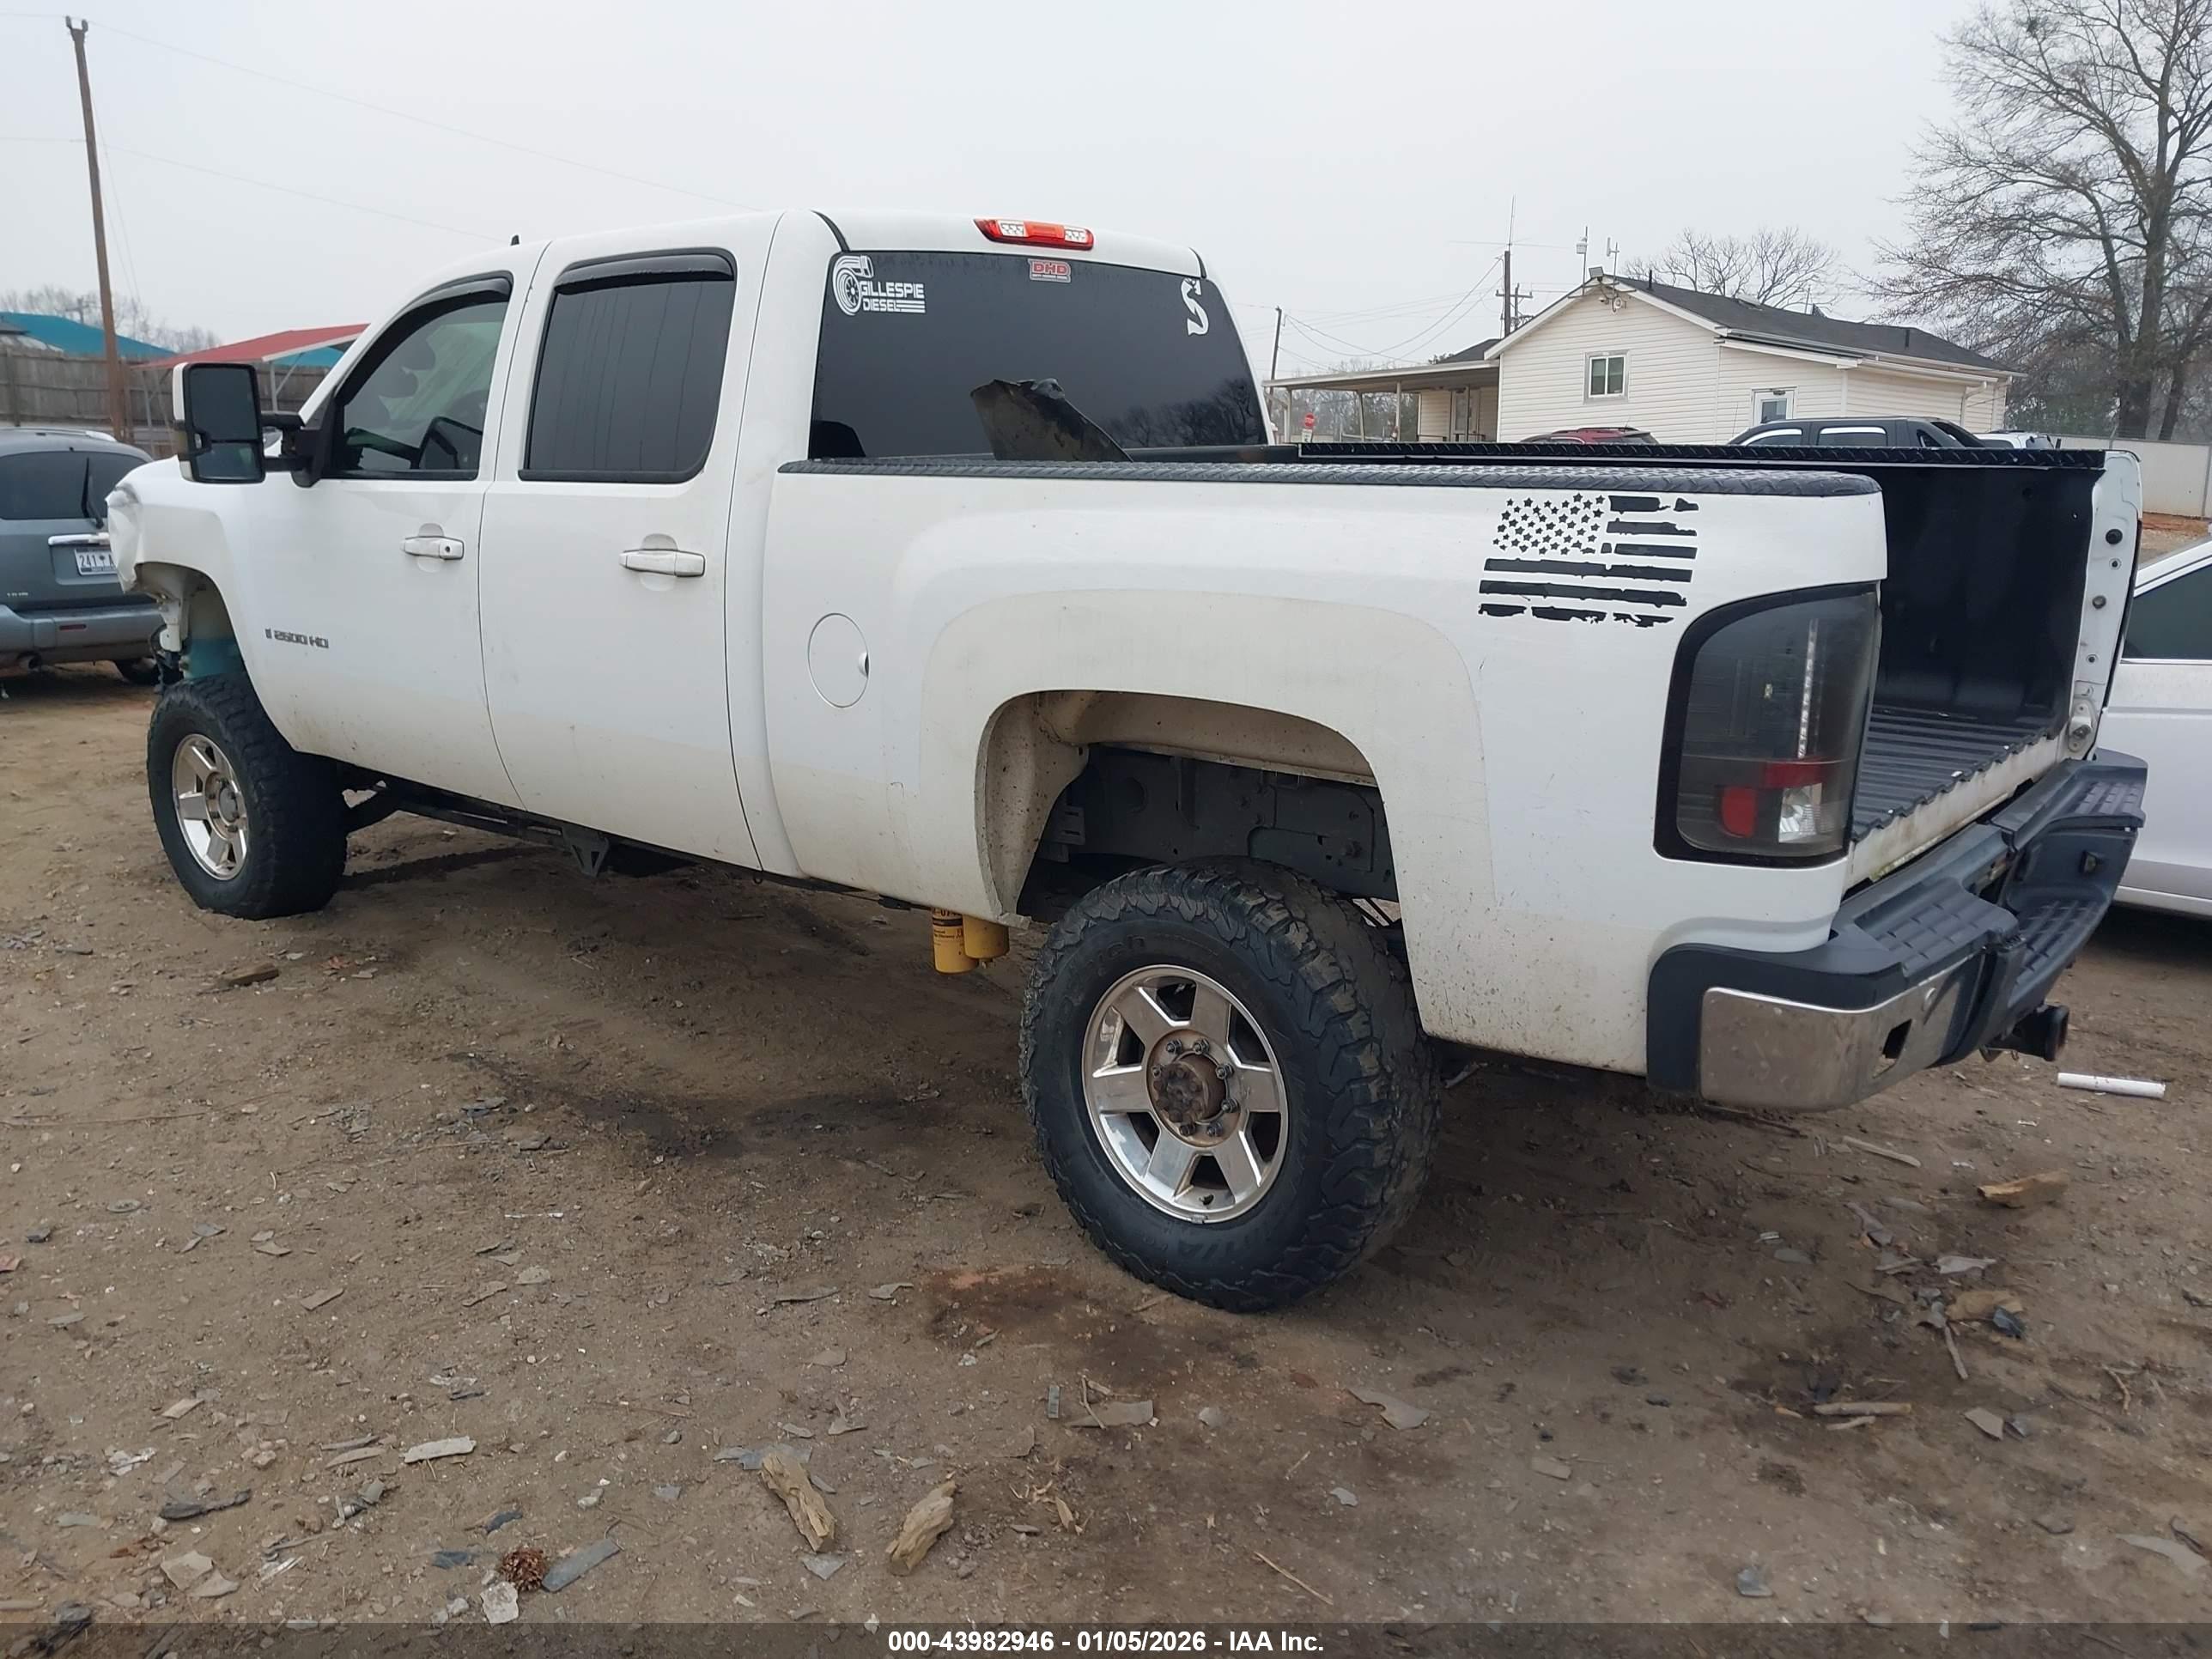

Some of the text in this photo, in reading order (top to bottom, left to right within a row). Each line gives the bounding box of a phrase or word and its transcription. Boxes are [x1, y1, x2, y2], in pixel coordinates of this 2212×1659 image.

[1032, 261, 1068, 275] DHD
[860, 281, 924, 299] GILLESPIE
[863, 298, 901, 312] DIESEL
